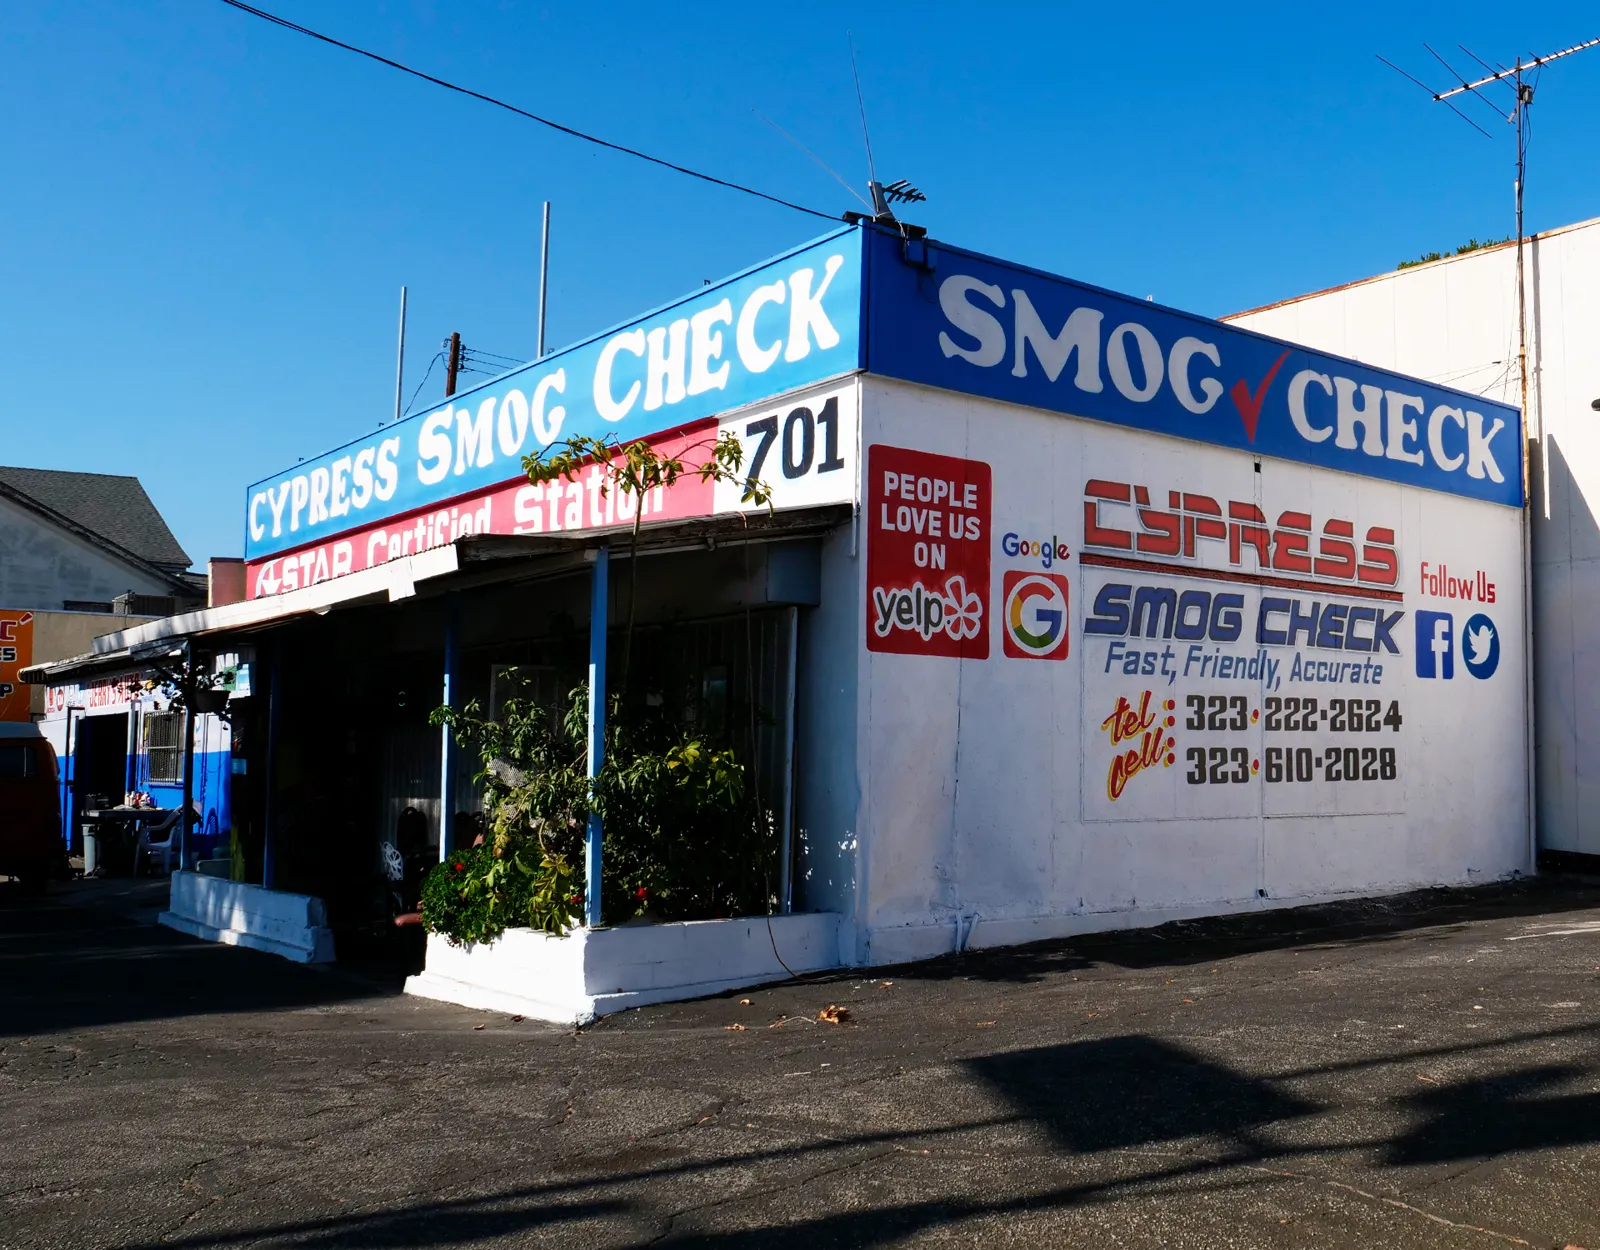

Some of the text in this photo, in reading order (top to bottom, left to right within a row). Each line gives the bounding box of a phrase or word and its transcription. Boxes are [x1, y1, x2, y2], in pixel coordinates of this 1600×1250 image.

[250, 254, 844, 541] CYPRESS SMOG CHECK
[938, 274, 1505, 483] SMOG CHECK
[743, 395, 845, 493] 701
[883, 471, 978, 510] PEOPLE
[881, 503, 981, 541] LOVE US
[1083, 479, 1398, 588] CYPRESS
[914, 541, 946, 570] ON
[1002, 532, 1070, 569] Google
[1421, 561, 1496, 603] Follow Us
[1083, 583, 1404, 654] SMOG CHECK
[1104, 641, 1384, 692] Fast, Friendly, Accurate
